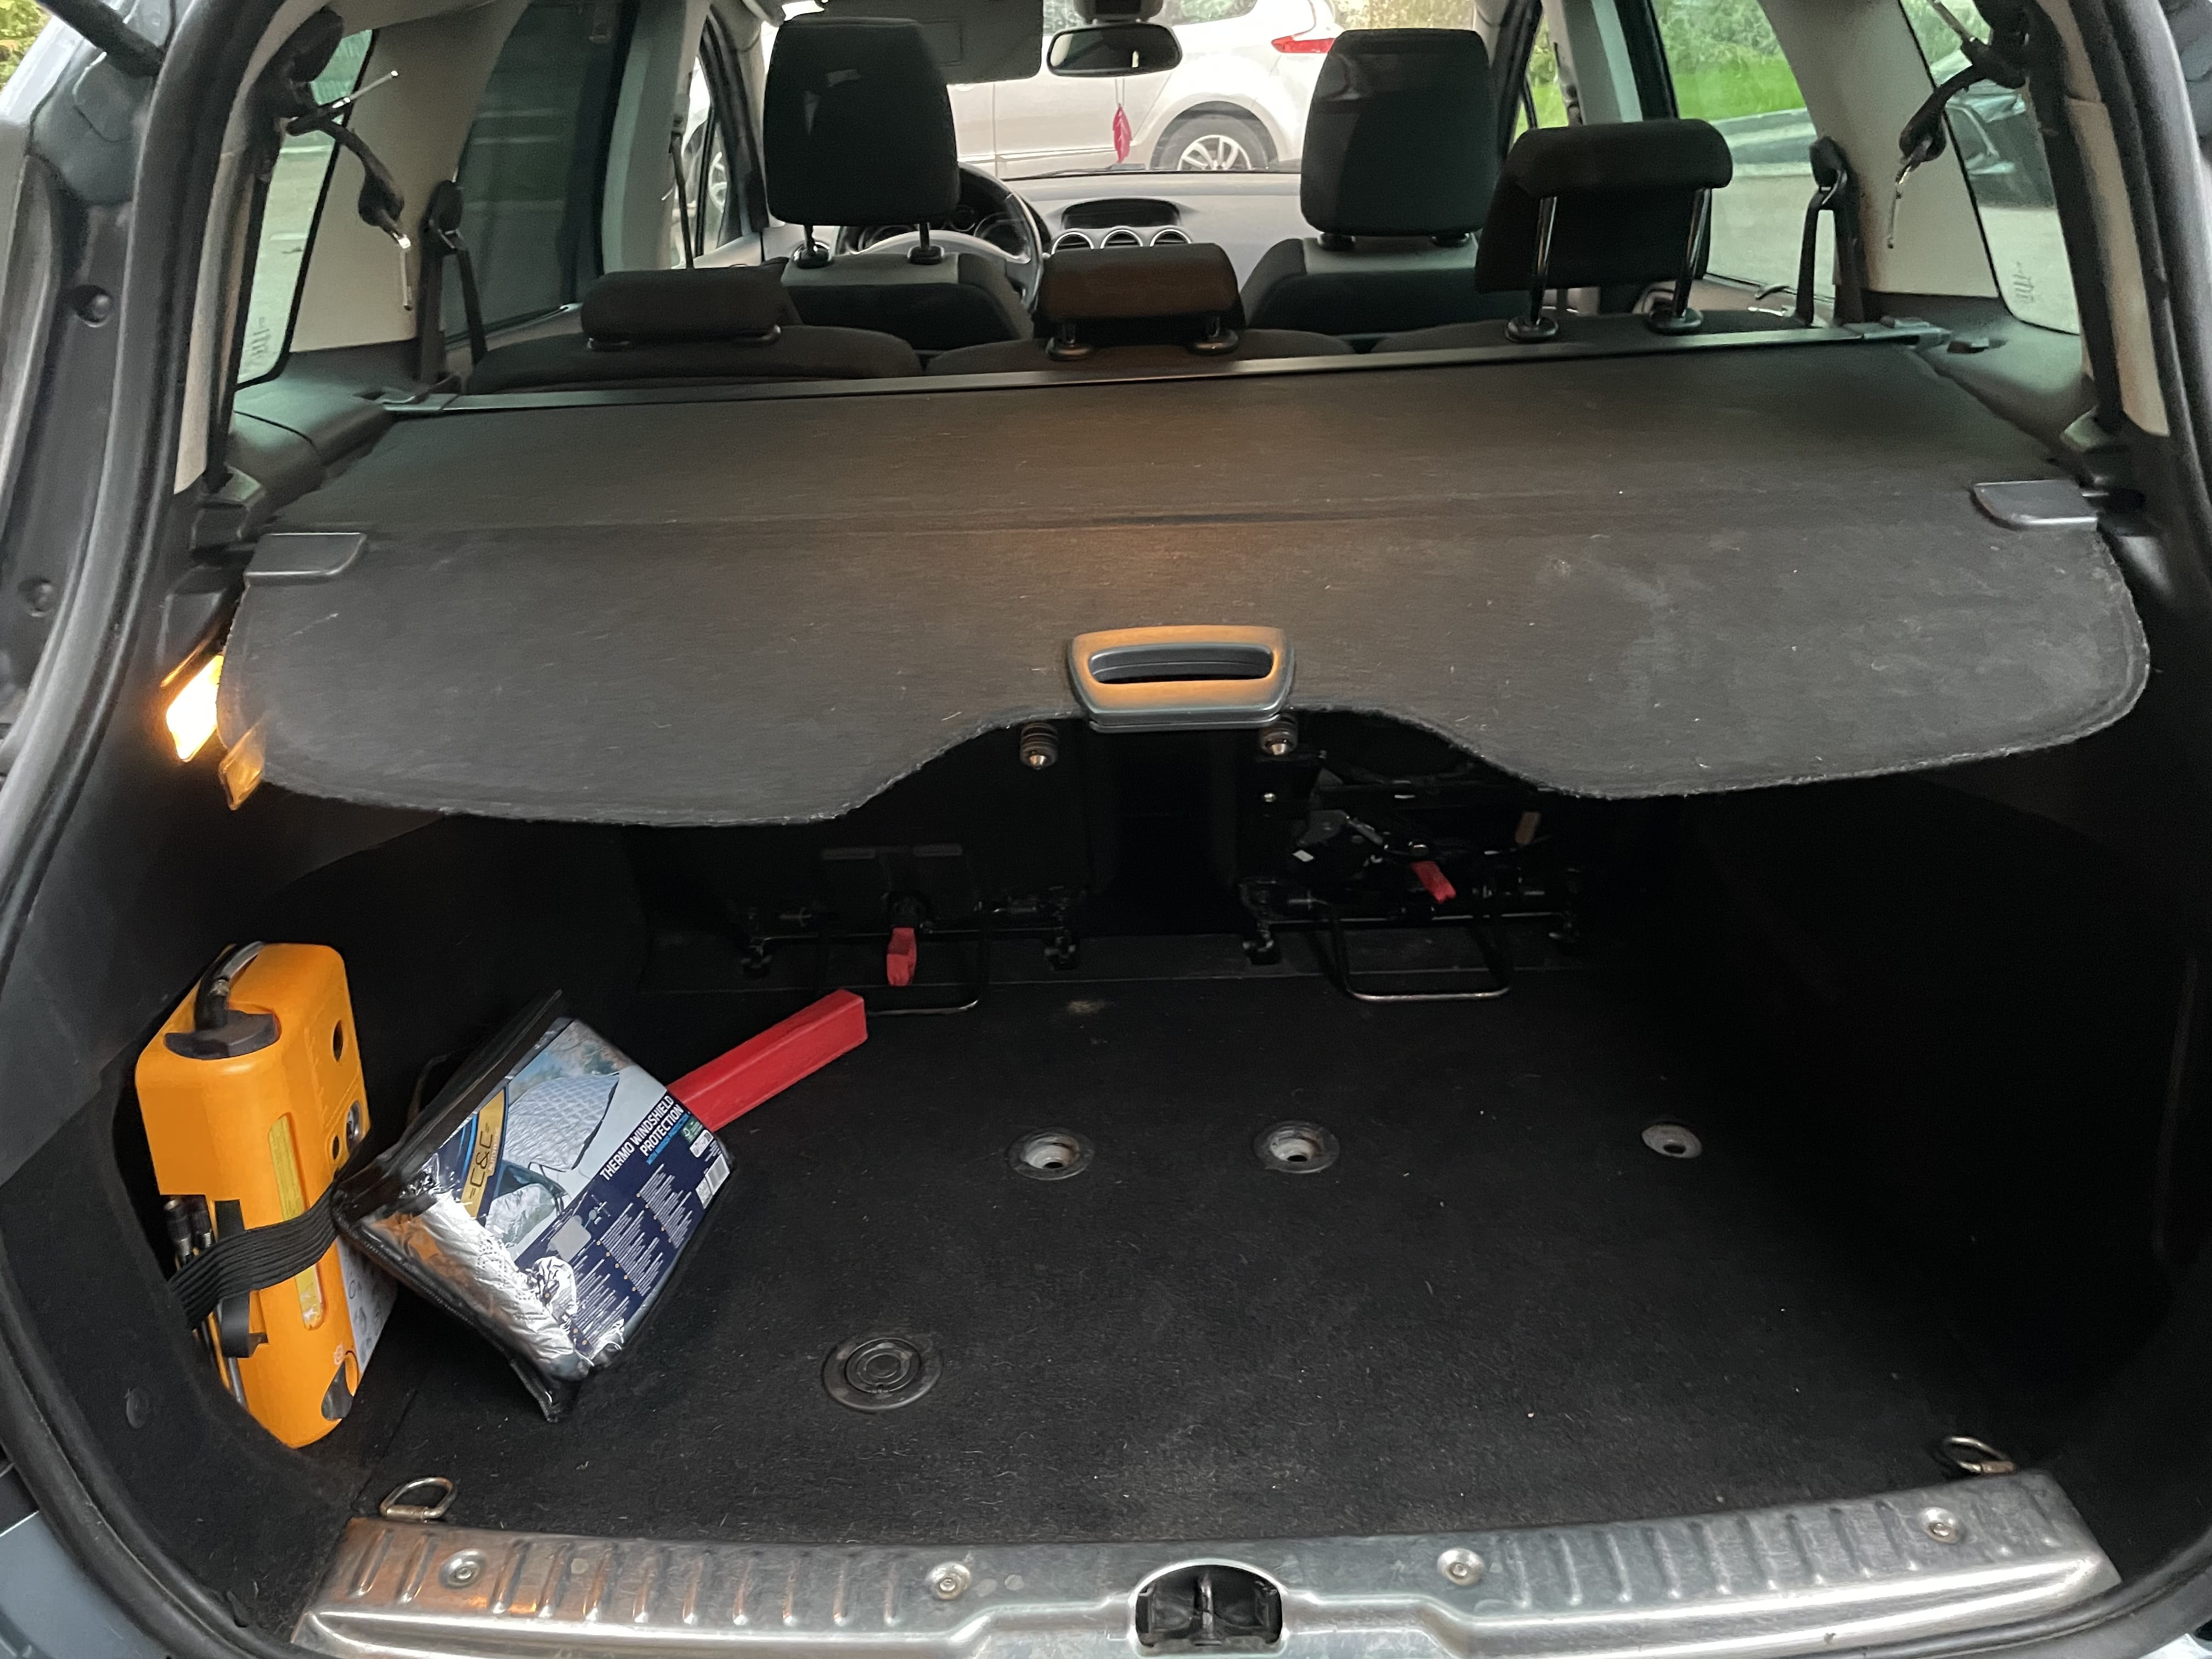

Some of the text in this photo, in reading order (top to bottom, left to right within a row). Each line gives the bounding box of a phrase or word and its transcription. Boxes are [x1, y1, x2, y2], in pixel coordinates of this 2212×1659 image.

[600, 1142, 635, 1181] THERMO
[630, 1095, 674, 1146] WINDSHIELD
[639, 1104, 684, 1157] PROTECTION
